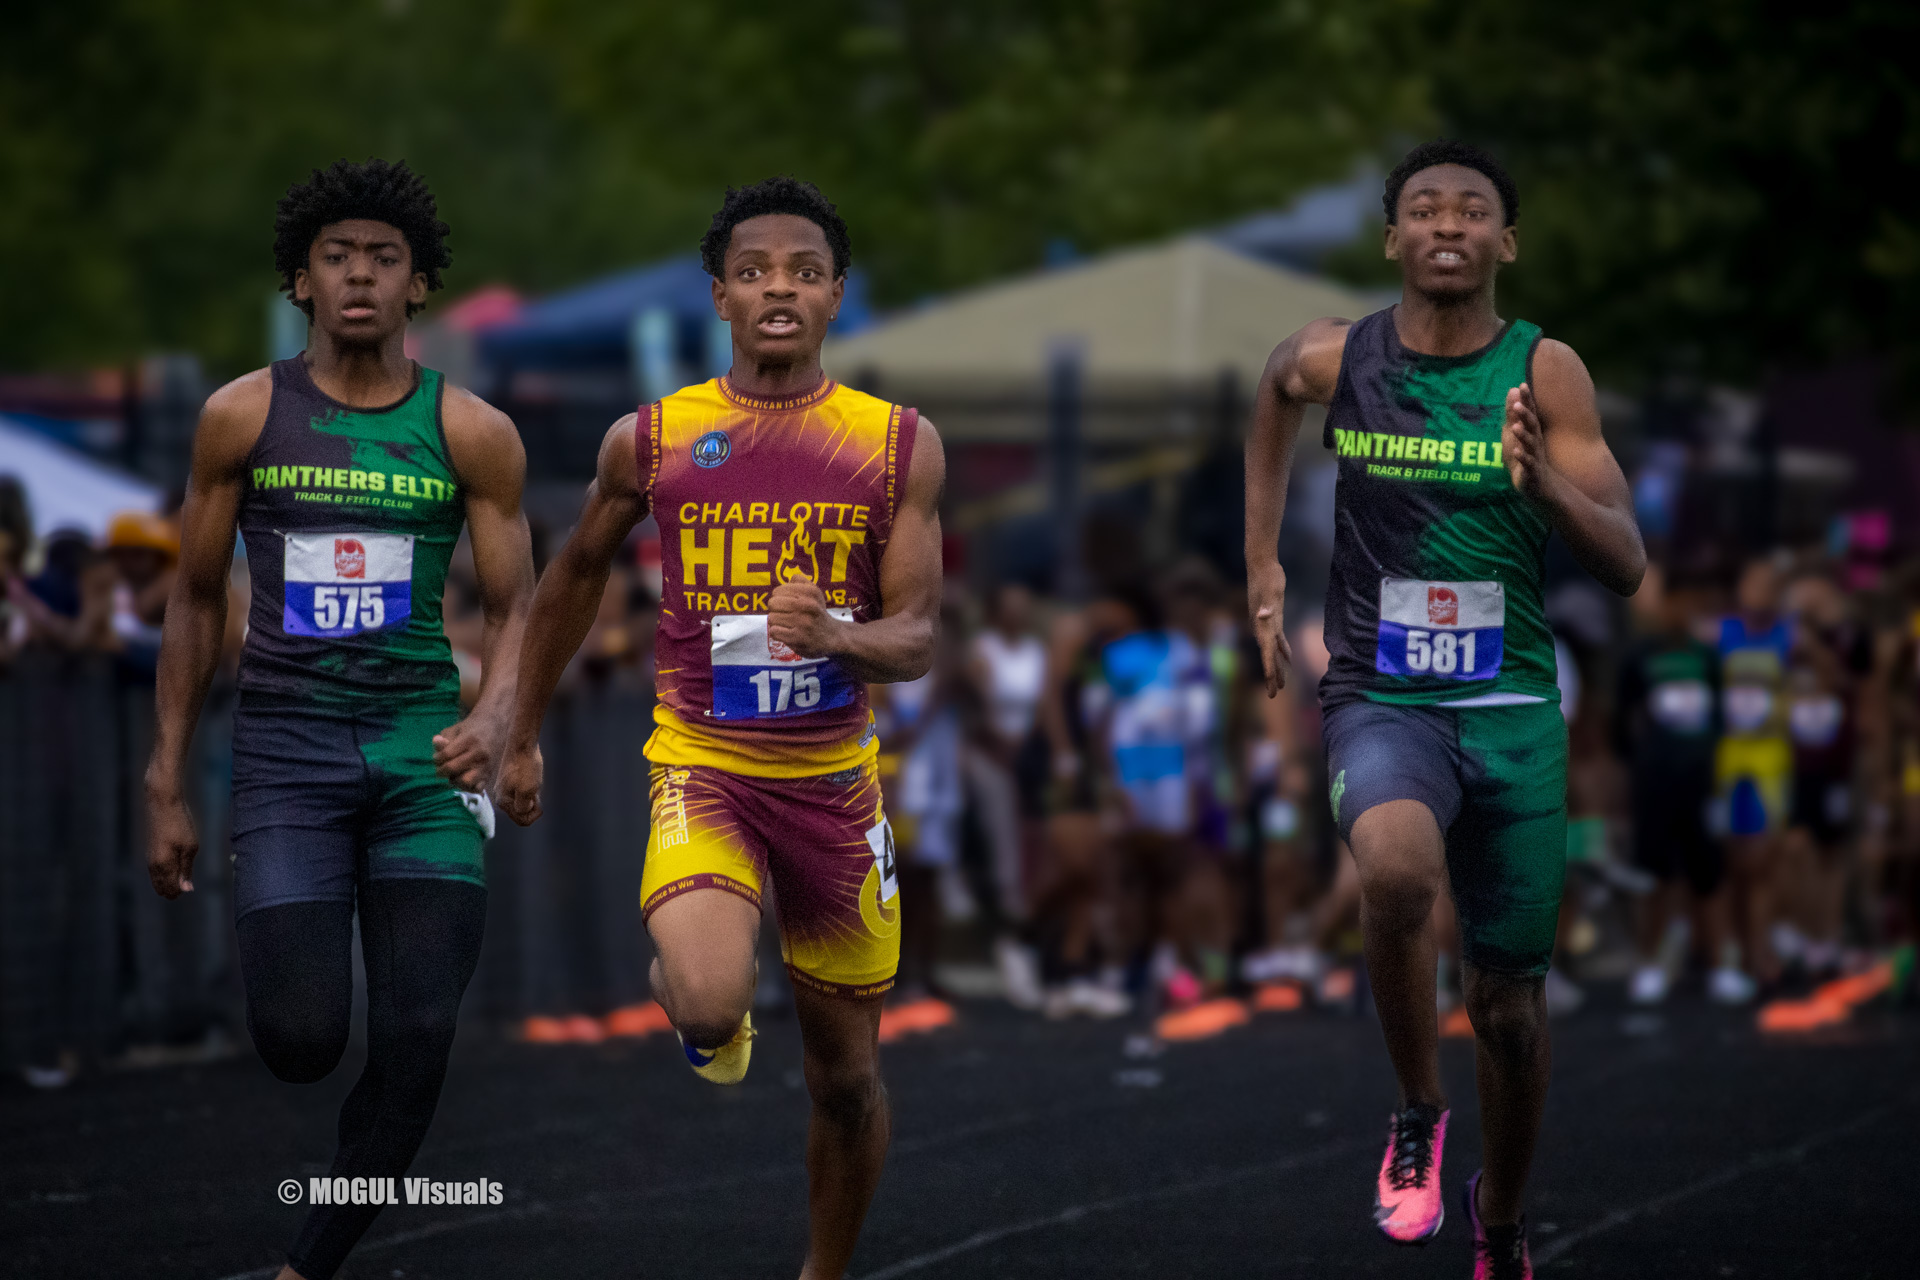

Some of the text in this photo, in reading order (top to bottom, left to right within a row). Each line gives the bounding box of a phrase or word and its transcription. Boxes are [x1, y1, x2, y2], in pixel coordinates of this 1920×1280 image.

[735, 394, 782, 410] AMERICAN
[785, 400, 794, 409] IS
[796, 394, 813, 406] THE
[888, 414, 900, 462] AMERICAN
[1334, 428, 1504, 468] PANTHERS ELI
[652, 459, 660, 469] IS
[888, 465, 896, 475] IS
[1367, 464, 1481, 483] TRACK & FIELD CLUB
[253, 465, 386, 491] PANTHERS
[887, 478, 895, 498] THE
[294, 491, 413, 510] TRACK & FIELD CLUB
[679, 502, 870, 528] CHARLOTTE
[313, 586, 384, 629] 575
[683, 591, 768, 611] TRACK
[1406, 630, 1476, 673] 581
[749, 667, 821, 713] 175
[668, 885, 677, 893] to
[677, 879, 695, 889] Win
[712, 876, 727, 886] You
[854, 988, 868, 996] You
